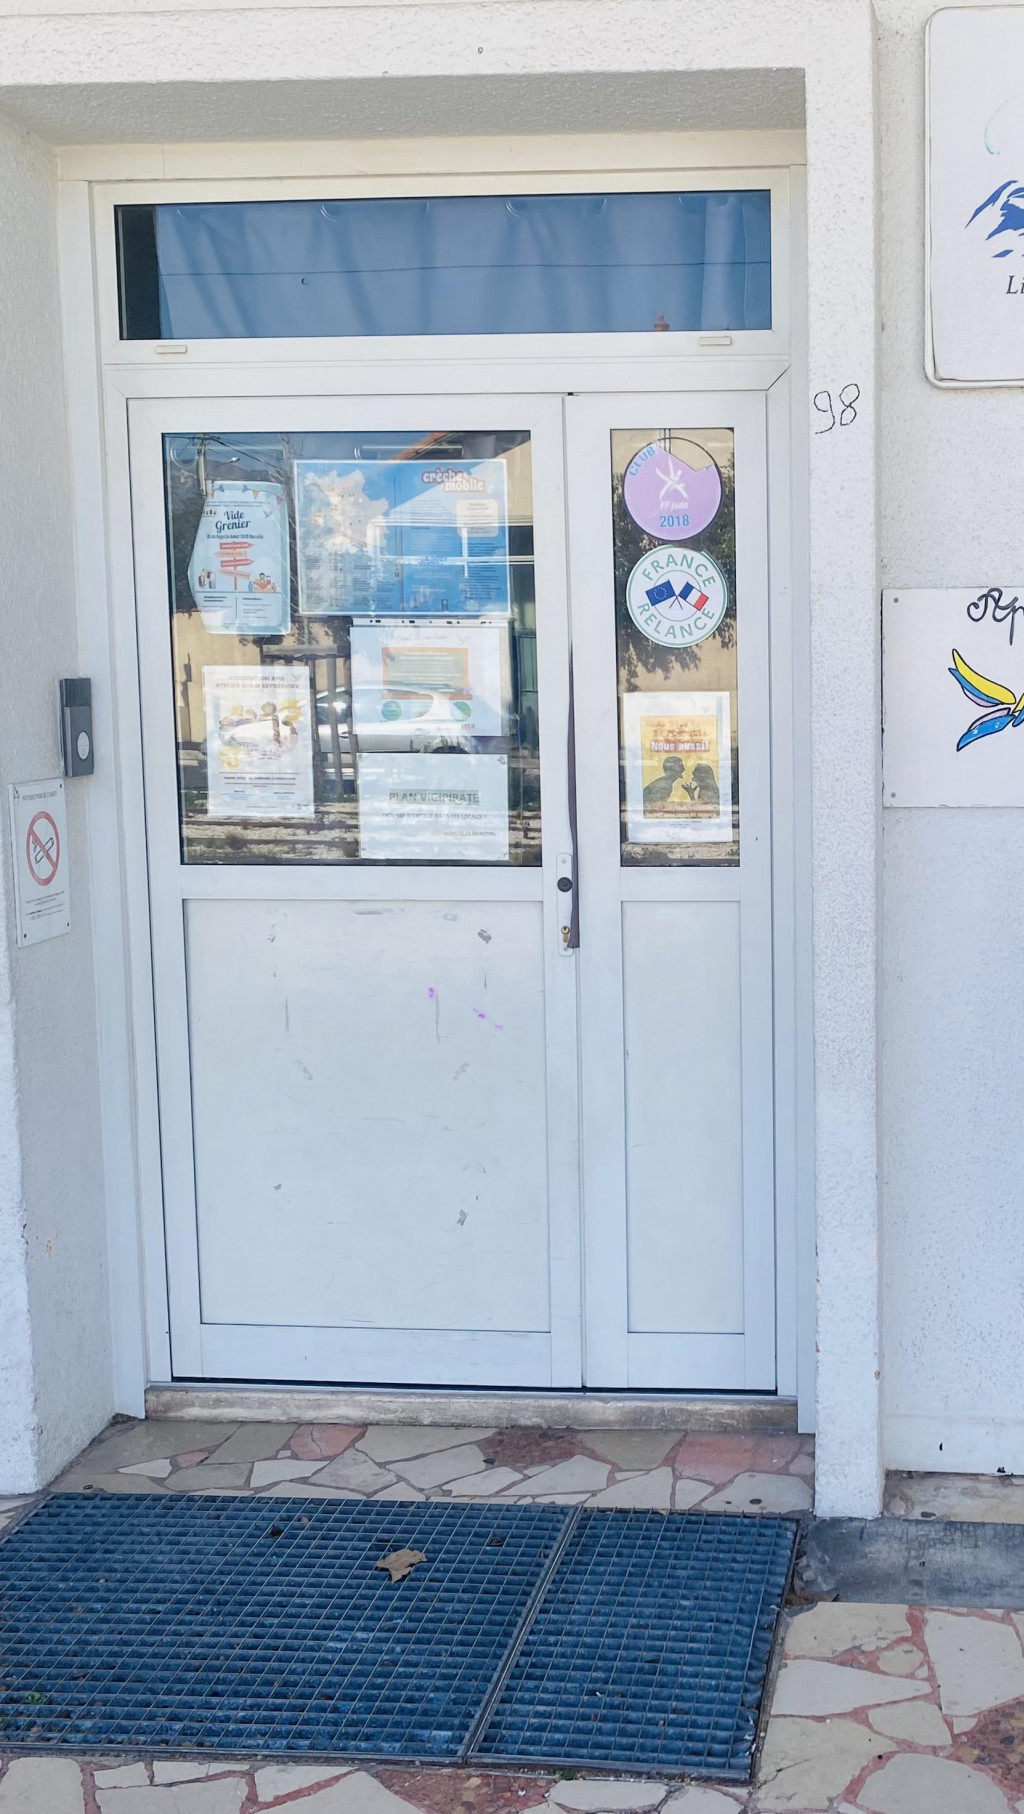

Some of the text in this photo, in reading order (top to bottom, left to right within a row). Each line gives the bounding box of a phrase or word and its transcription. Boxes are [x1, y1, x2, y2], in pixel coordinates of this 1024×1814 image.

[813, 383, 861, 435] 98
[628, 446, 656, 477] CLUB
[421, 467, 464, 484] crèche
[444, 478, 485, 493] mobile
[224, 510, 245, 521] Vide
[659, 514, 690, 528] 2018
[215, 519, 252, 534] Grenier
[641, 552, 716, 589] FRANCE
[637, 604, 716, 640] RELANCE
[651, 740, 676, 752] Nous
[388, 791, 418, 803] PLAN
